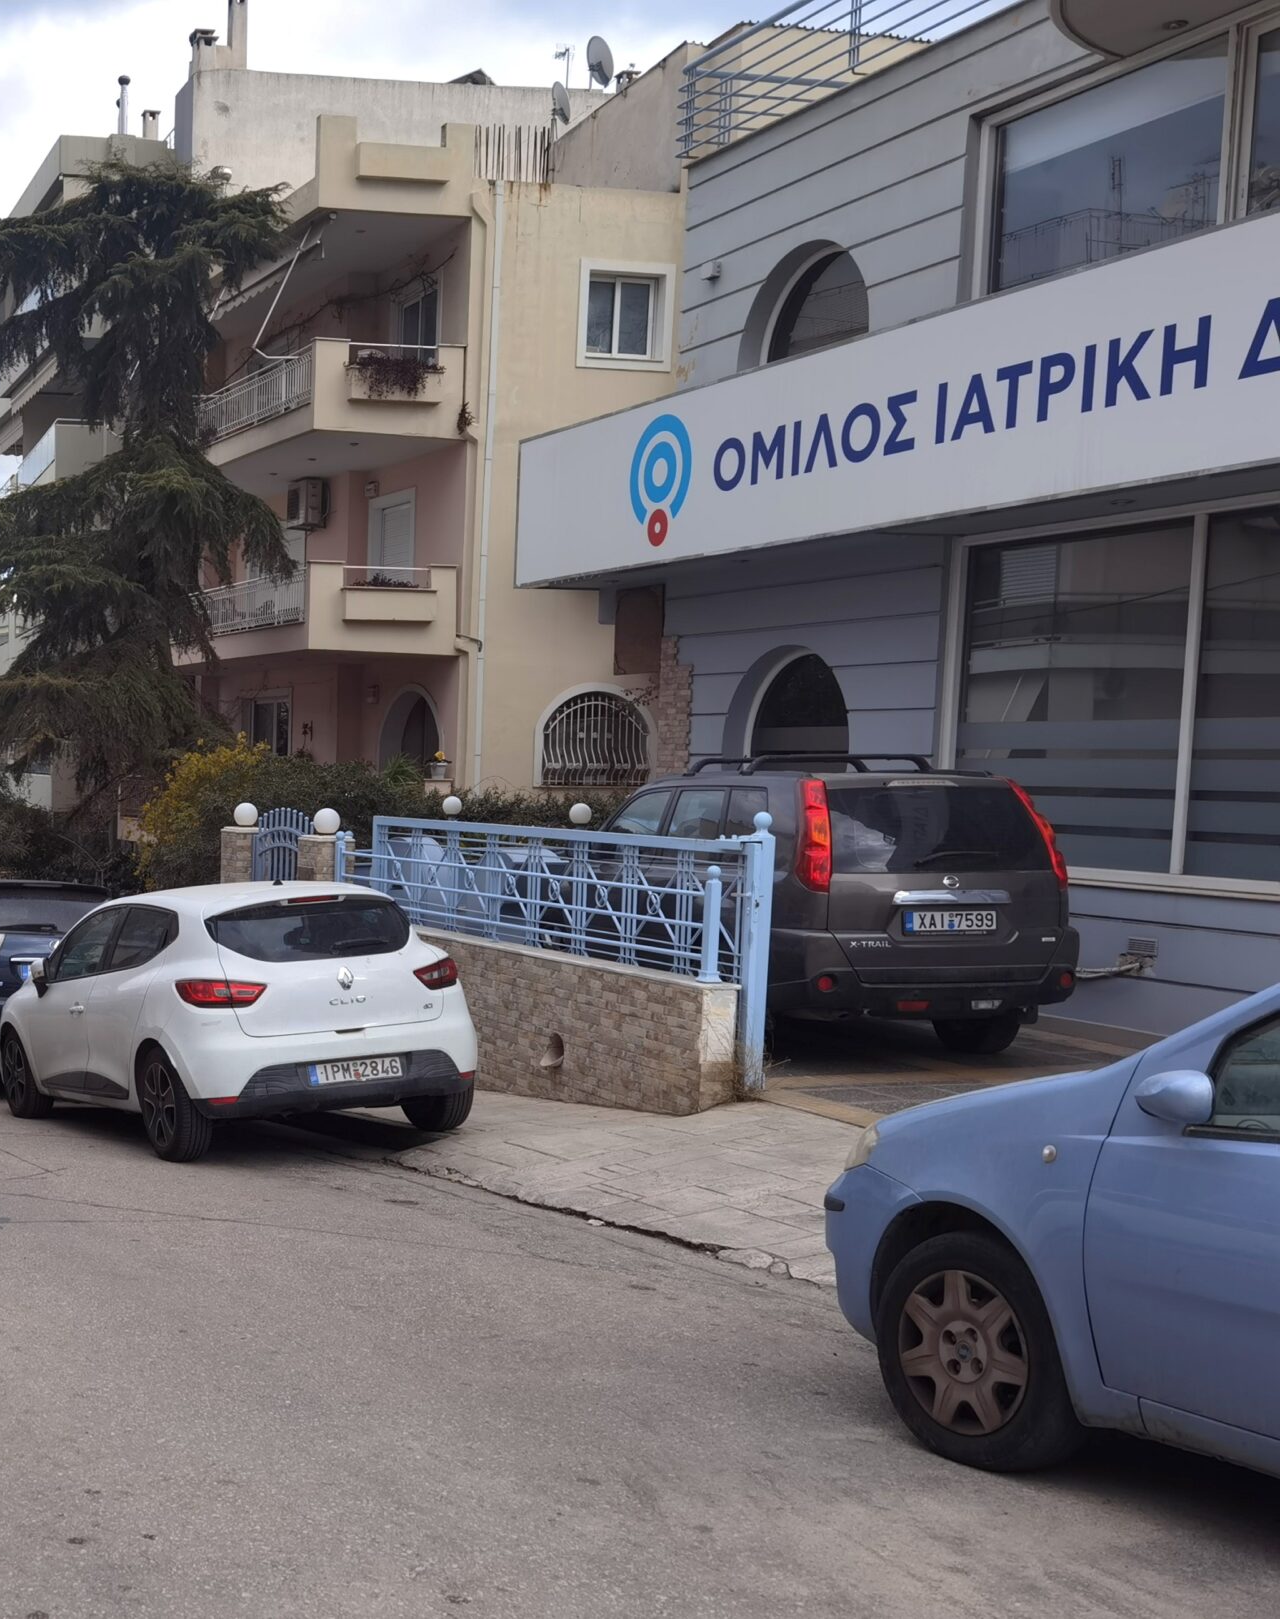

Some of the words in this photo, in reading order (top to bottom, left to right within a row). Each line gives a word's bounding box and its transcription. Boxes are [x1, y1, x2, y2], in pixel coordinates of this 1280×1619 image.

[713, 389, 919, 492] ΟΜΙΛΟΣ
[933, 315, 1213, 445] ΙΑΤΡΙΚΗ
[849, 940, 892, 949] X-TRAIL
[329, 995, 366, 1006] CLIO
